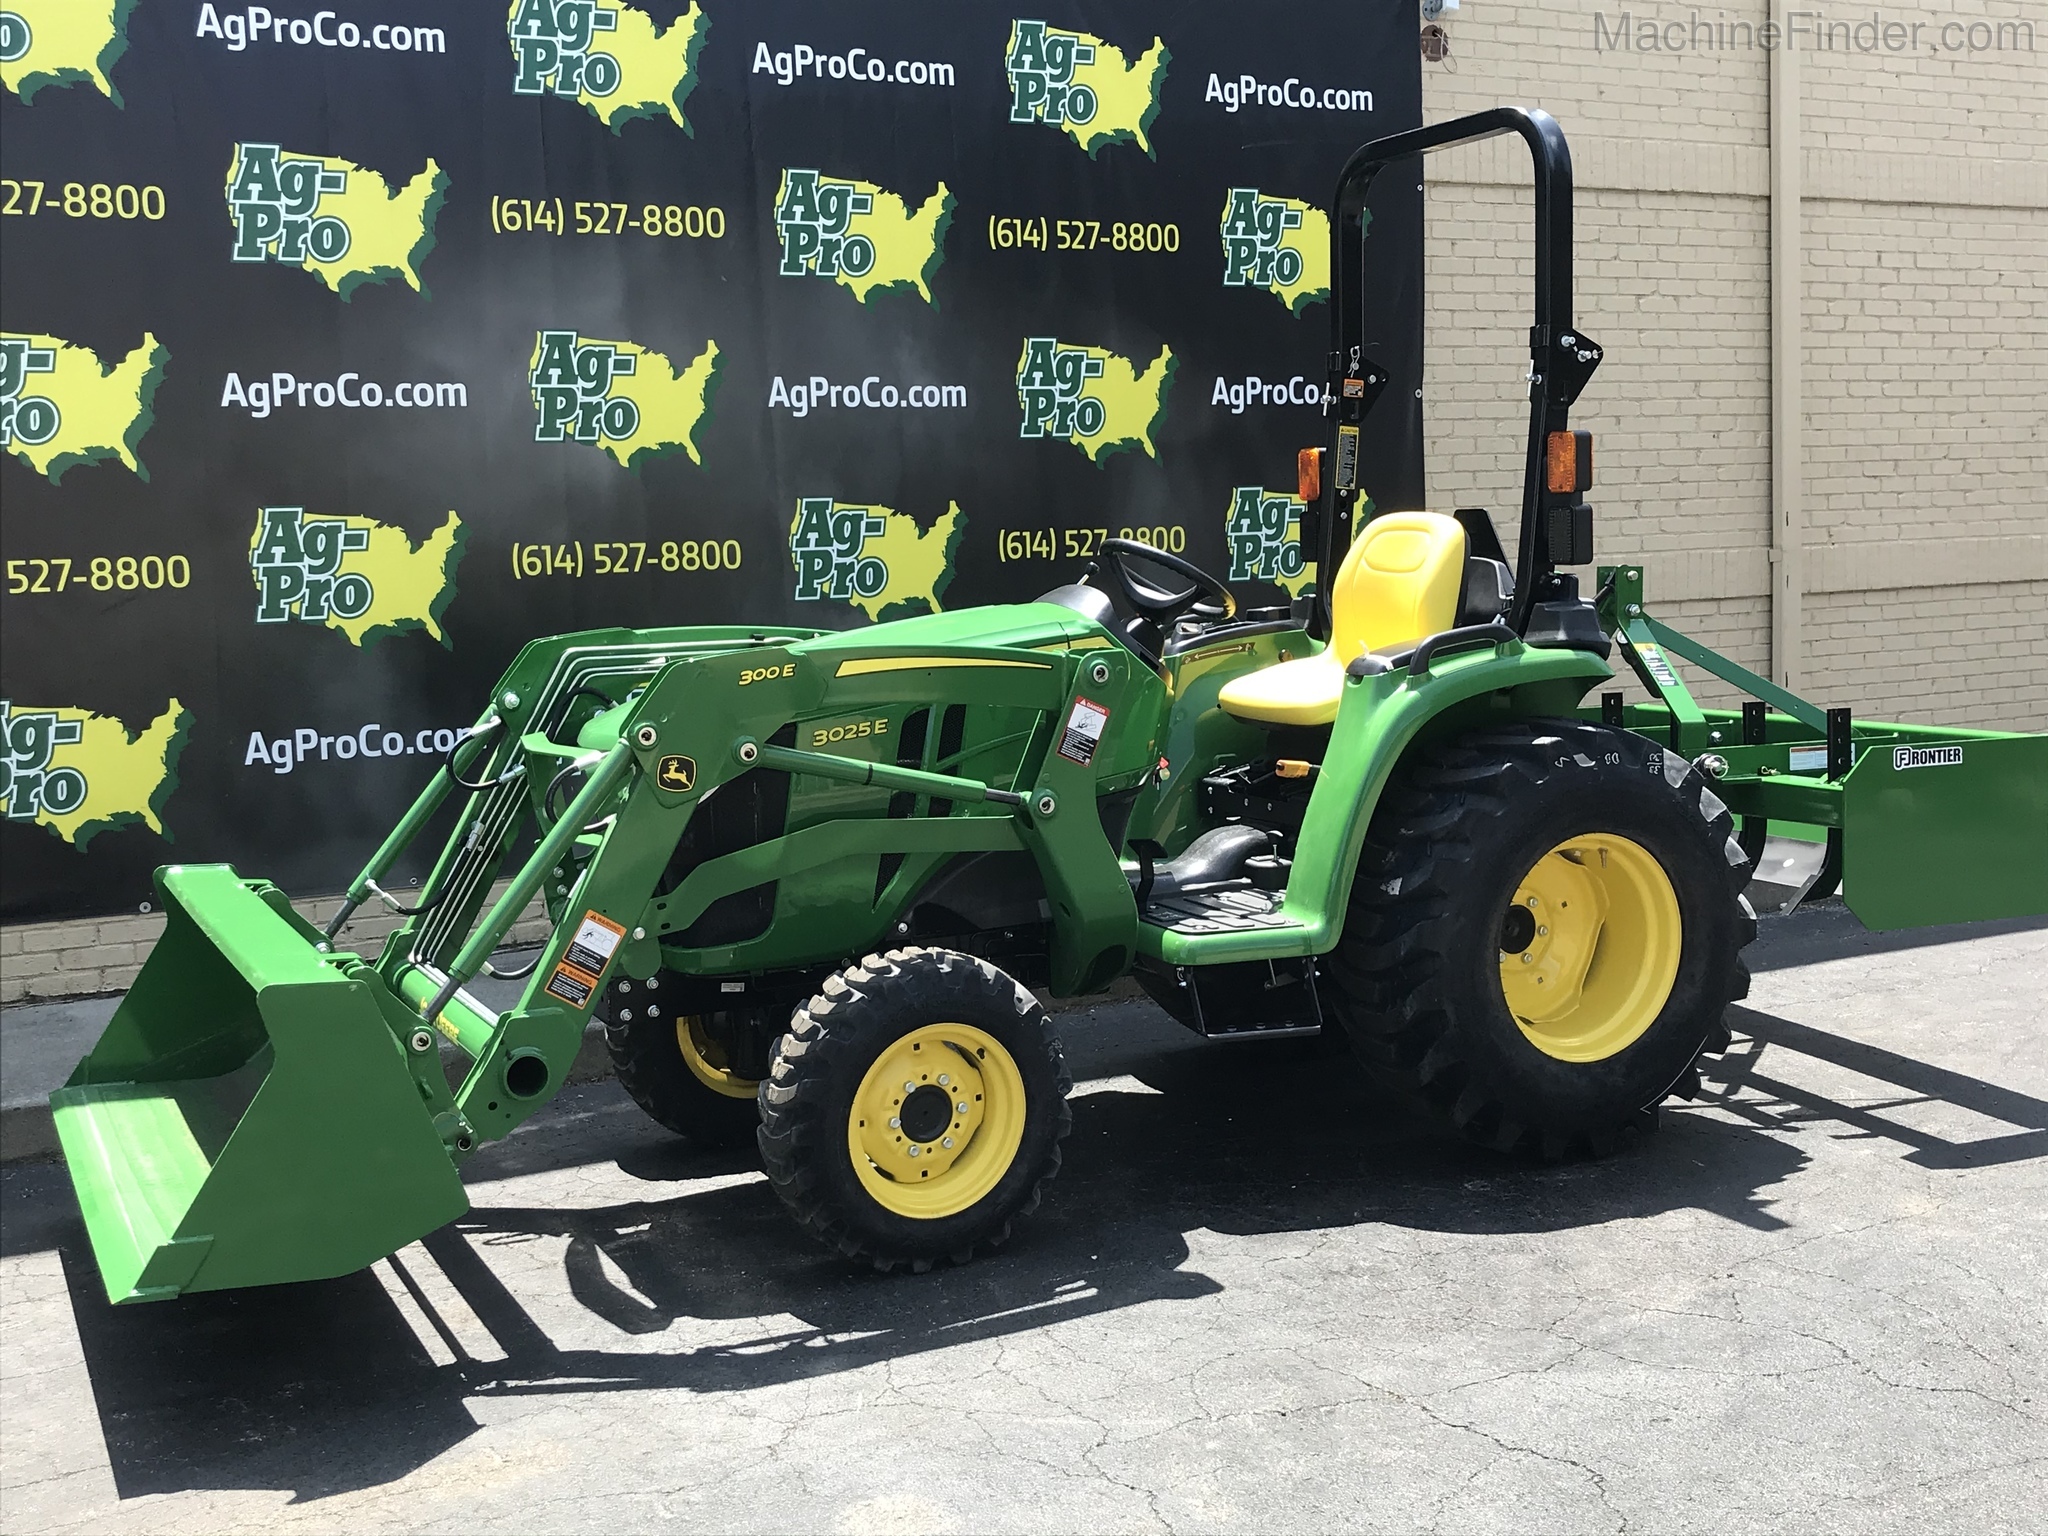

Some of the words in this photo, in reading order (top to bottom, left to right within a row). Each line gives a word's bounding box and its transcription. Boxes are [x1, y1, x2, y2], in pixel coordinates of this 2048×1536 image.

[196, 2, 446, 53] AgProCo.com
[511, 0, 618, 52] Ag-
[1010, 19, 1094, 82] Ag-
[514, 37, 620, 95] Pro
[752, 41, 955, 86] AgProCo.com
[1011, 70, 1097, 122] Pro
[1205, 73, 1373, 112] AgProCo.com
[0, 179, 166, 220] 27-8800
[230, 143, 346, 215] Ag-
[778, 169, 872, 234] Ag-
[233, 203, 350, 262] Pro
[491, 195, 564, 236] (614)
[574, 199, 726, 239] 527-8800
[989, 215, 1049, 252] (614)
[1056, 220, 1181, 252] 527-8800
[1224, 188, 1301, 248] Ag-
[780, 222, 875, 275] Pro
[1225, 237, 1302, 286] Pro
[0, 340, 54, 399] g-
[534, 331, 636, 398] Ag-
[1021, 338, 1104, 401] Ag-
[220, 372, 468, 418] AgProCo.com
[535, 386, 639, 441] Pro
[768, 376, 967, 416] AgProCo.com
[1021, 388, 1105, 437] Pro
[1211, 376, 1324, 414] AgProCo
[793, 498, 886, 562] Ag-
[1227, 487, 1306, 543] Ag-
[254, 508, 370, 580] Ag-
[512, 540, 584, 580] (614)
[594, 539, 743, 575] 527-8800
[999, 527, 1057, 563] (614)
[1065, 525, 1186, 559] 527800
[1229, 533, 1306, 581] Pro
[7, 555, 191, 594] 527-8800
[257, 564, 372, 621] Pro
[795, 549, 888, 600] Pro
[738, 668, 780, 686] 300
[782, 663, 796, 678] E
[812, 721, 872, 747] 3025
[874, 718, 889, 735] E
[1894, 746, 1962, 769] FRONTIER
